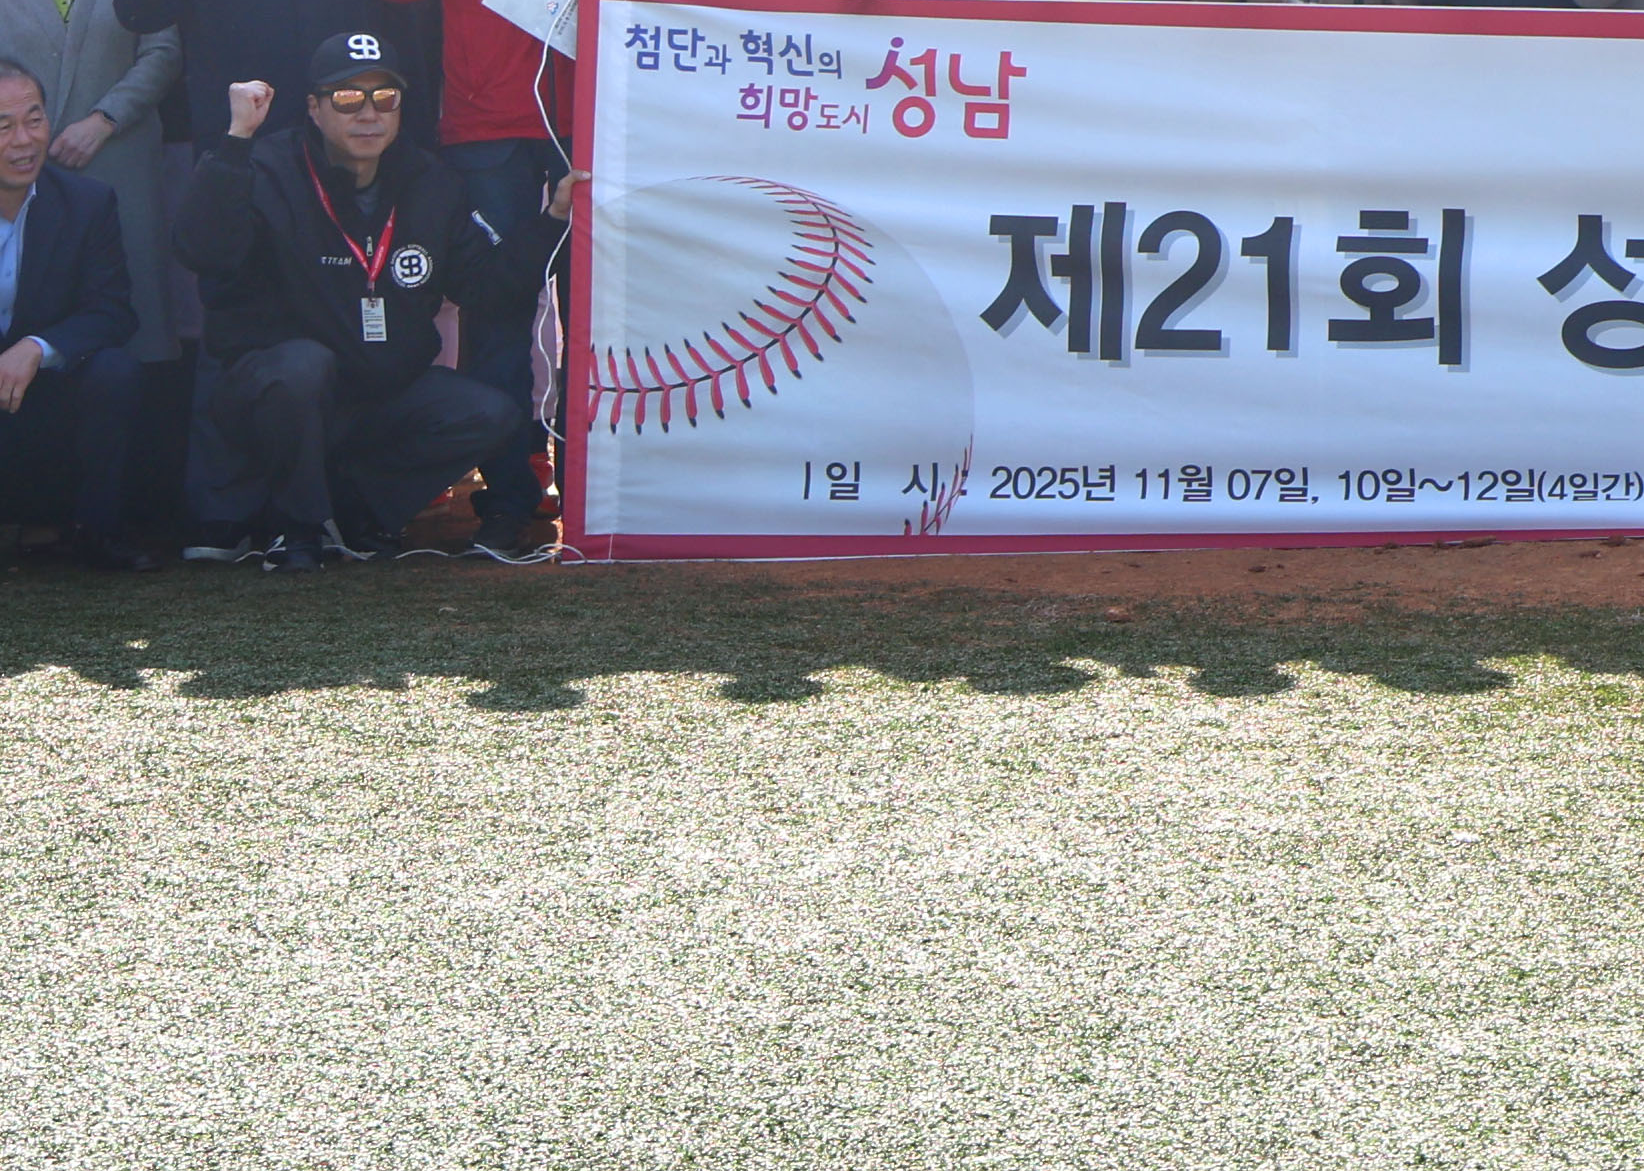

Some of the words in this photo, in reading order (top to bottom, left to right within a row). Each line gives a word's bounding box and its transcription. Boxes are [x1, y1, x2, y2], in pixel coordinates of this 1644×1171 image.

[625, 24, 732, 75] 첨단과
[739, 29, 842, 80] 혁신의
[736, 82, 869, 135] 희망도시
[865, 36, 1027, 140] 성남
[980, 201, 1470, 368] 제21회
[825, 461, 861, 501] 일
[902, 462, 939, 502] 시
[989, 464, 1116, 502] 2025년
[1135, 464, 1213, 502] 11월
[1227, 466, 1319, 504] 07일,
